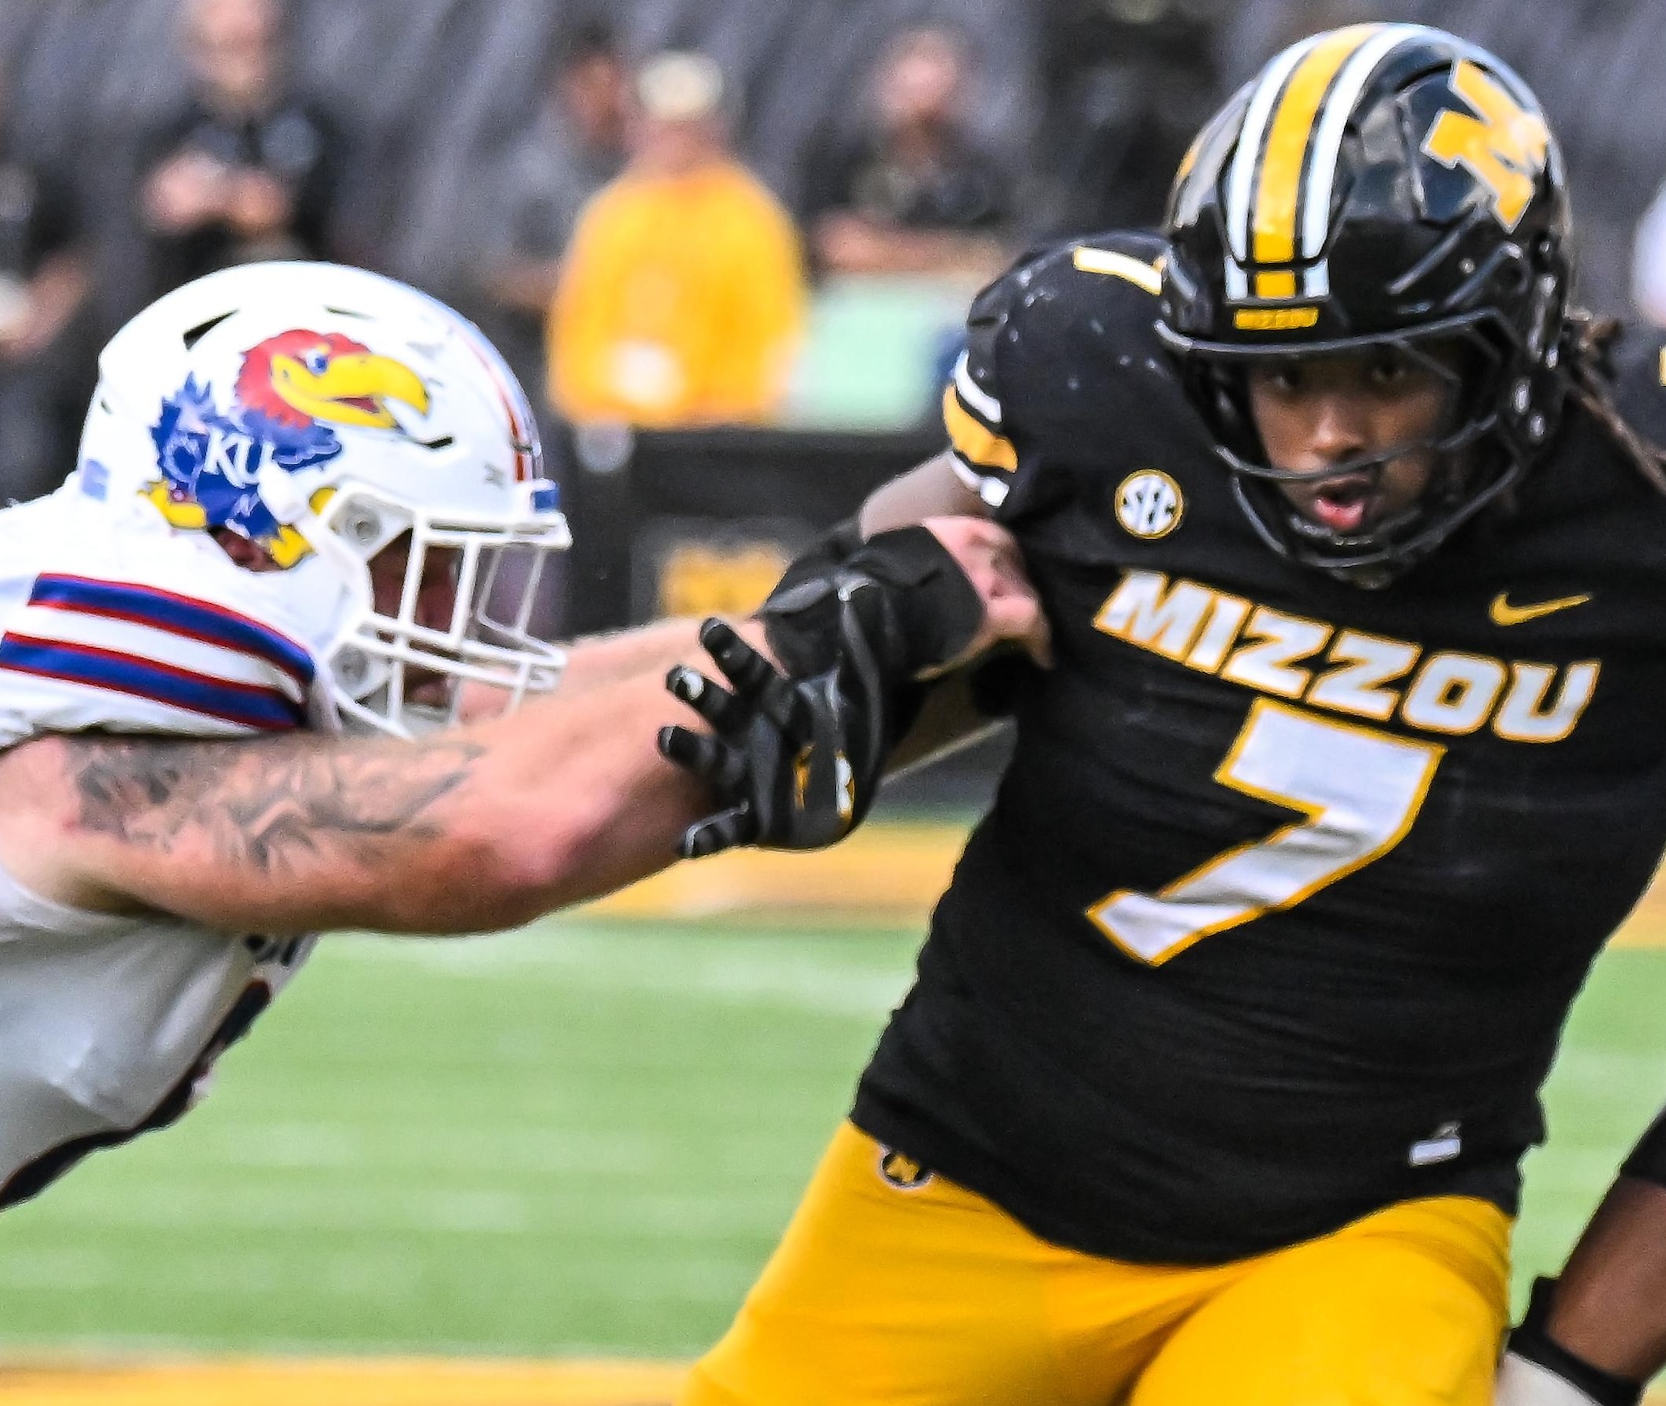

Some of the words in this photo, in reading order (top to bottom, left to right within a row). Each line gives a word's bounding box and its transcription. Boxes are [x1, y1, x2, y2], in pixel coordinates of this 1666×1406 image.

[203, 427, 276, 489] KU
[1092, 567, 1602, 744] MIZZOU
[1086, 698, 1447, 967] 7
